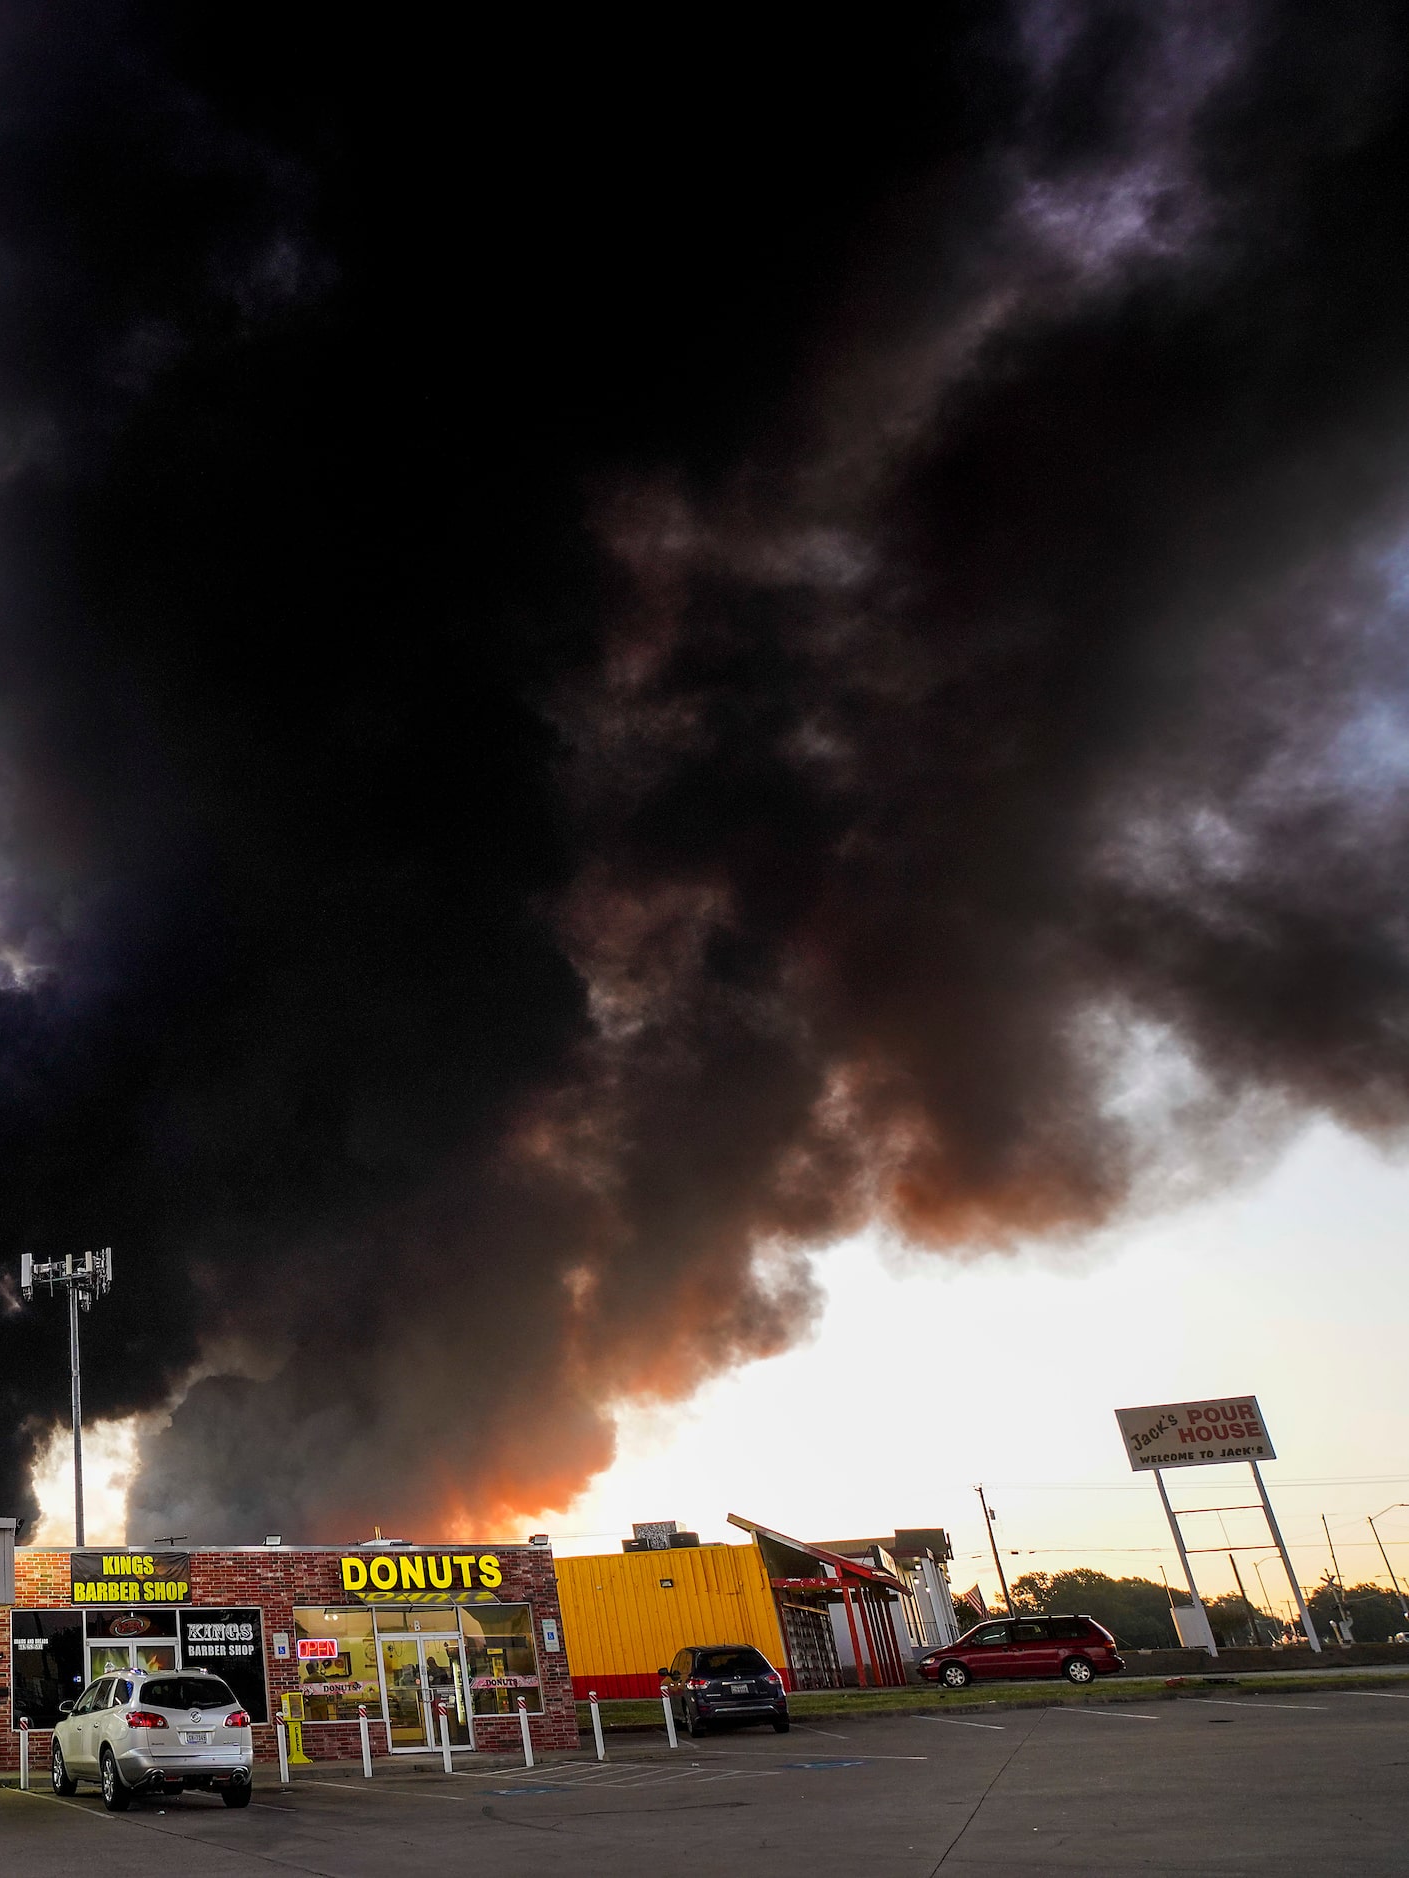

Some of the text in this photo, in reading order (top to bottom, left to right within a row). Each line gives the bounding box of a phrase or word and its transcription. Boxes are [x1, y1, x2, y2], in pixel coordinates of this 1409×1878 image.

[1186, 1403, 1256, 1425] POUR
[1131, 1413, 1178, 1451] Jack's
[1178, 1421, 1262, 1444] HOUSE
[1140, 1446, 1264, 1464] WELCOME TO JACK'S
[102, 1556, 154, 1575] KINGS
[341, 1554, 503, 1591] DONUTS
[73, 1581, 188, 1602] BARBER SHOP
[187, 1623, 254, 1641] KINGS
[414, 1620, 421, 1631] B
[188, 1644, 255, 1656] BARBER SHOP
[299, 1640, 336, 1657] OPEN
[323, 1684, 357, 1692] DONUTS
[486, 1678, 518, 1686] DONUTS
